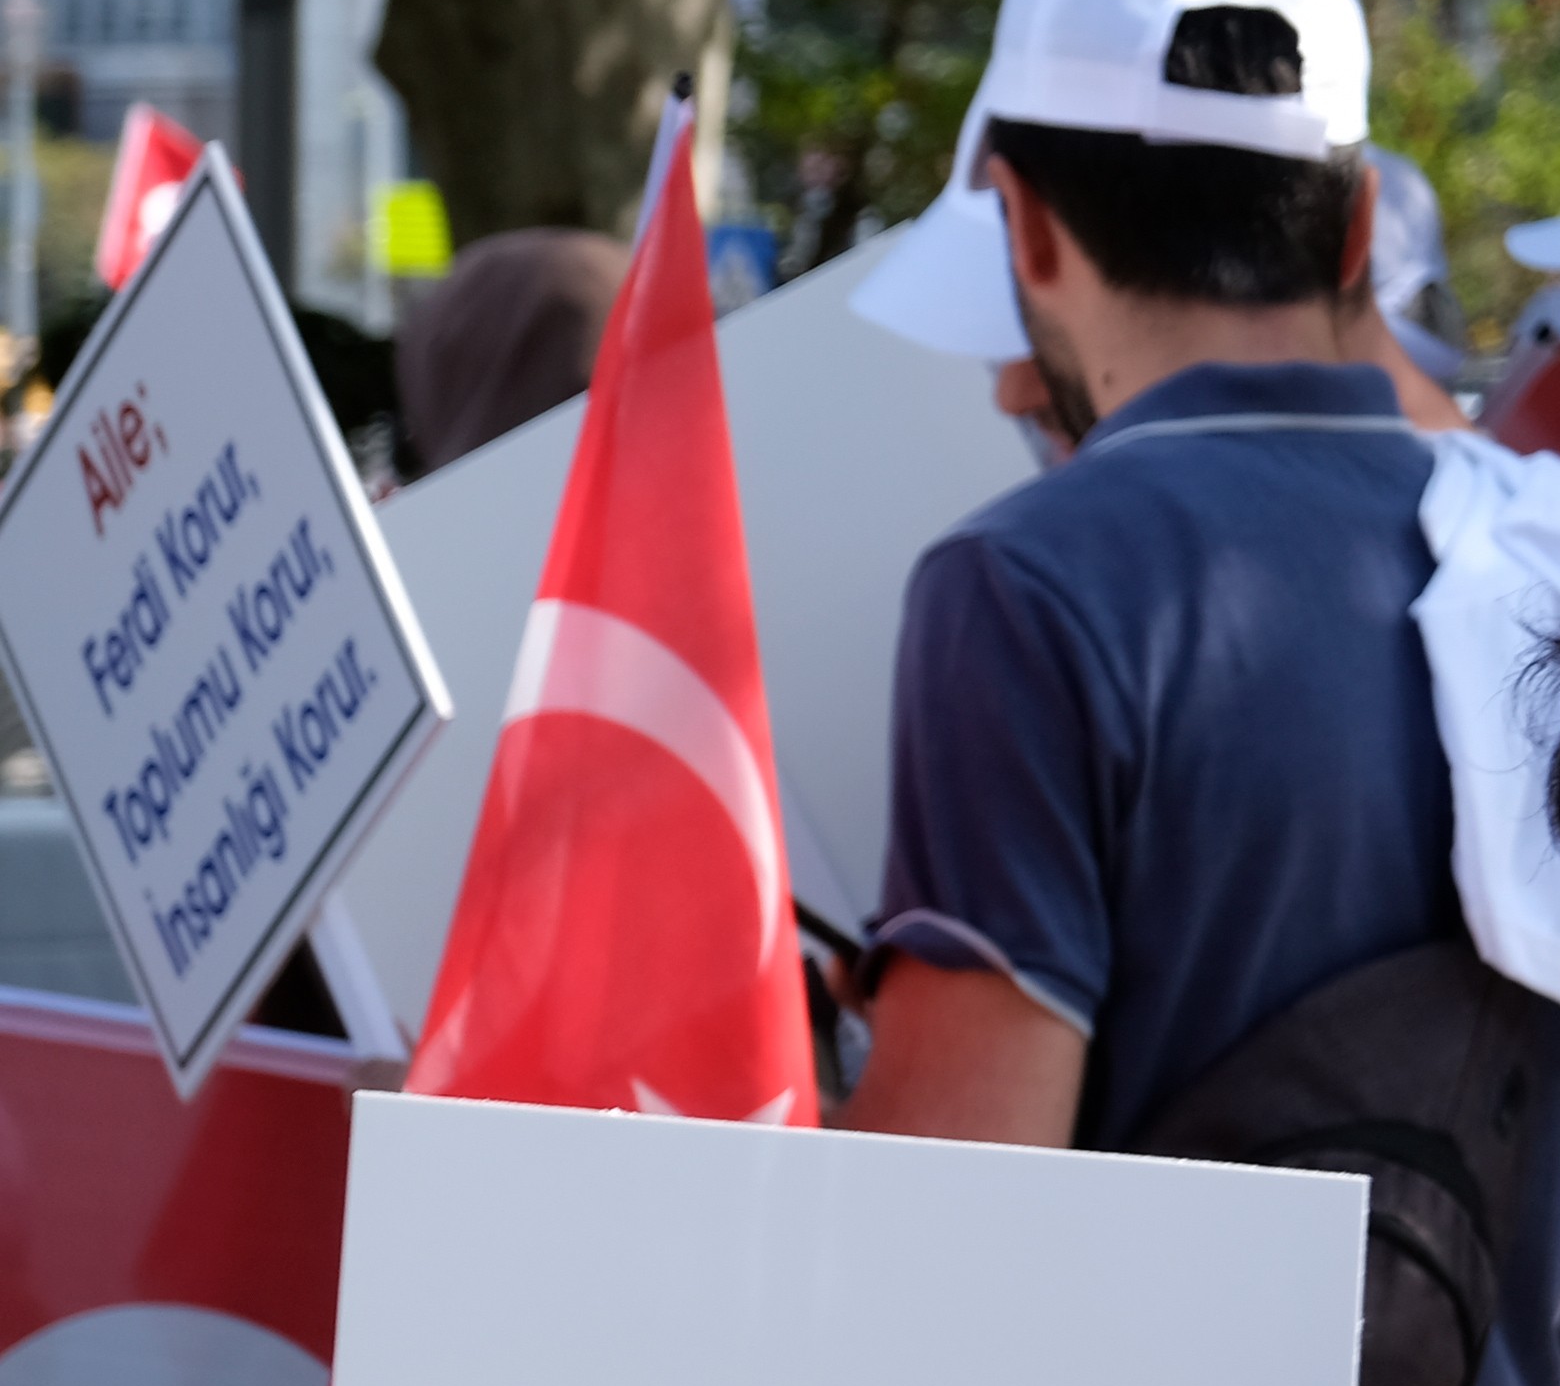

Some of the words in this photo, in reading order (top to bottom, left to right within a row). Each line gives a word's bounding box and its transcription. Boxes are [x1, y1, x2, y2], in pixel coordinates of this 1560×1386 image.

[83, 553, 170, 718] Ferdi
[155, 439, 260, 599] Korur,
[104, 645, 240, 863] Toplumu
[228, 516, 335, 675] Korur,
[144, 763, 288, 980] İnsanlığı
[272, 635, 377, 794] Korur.
